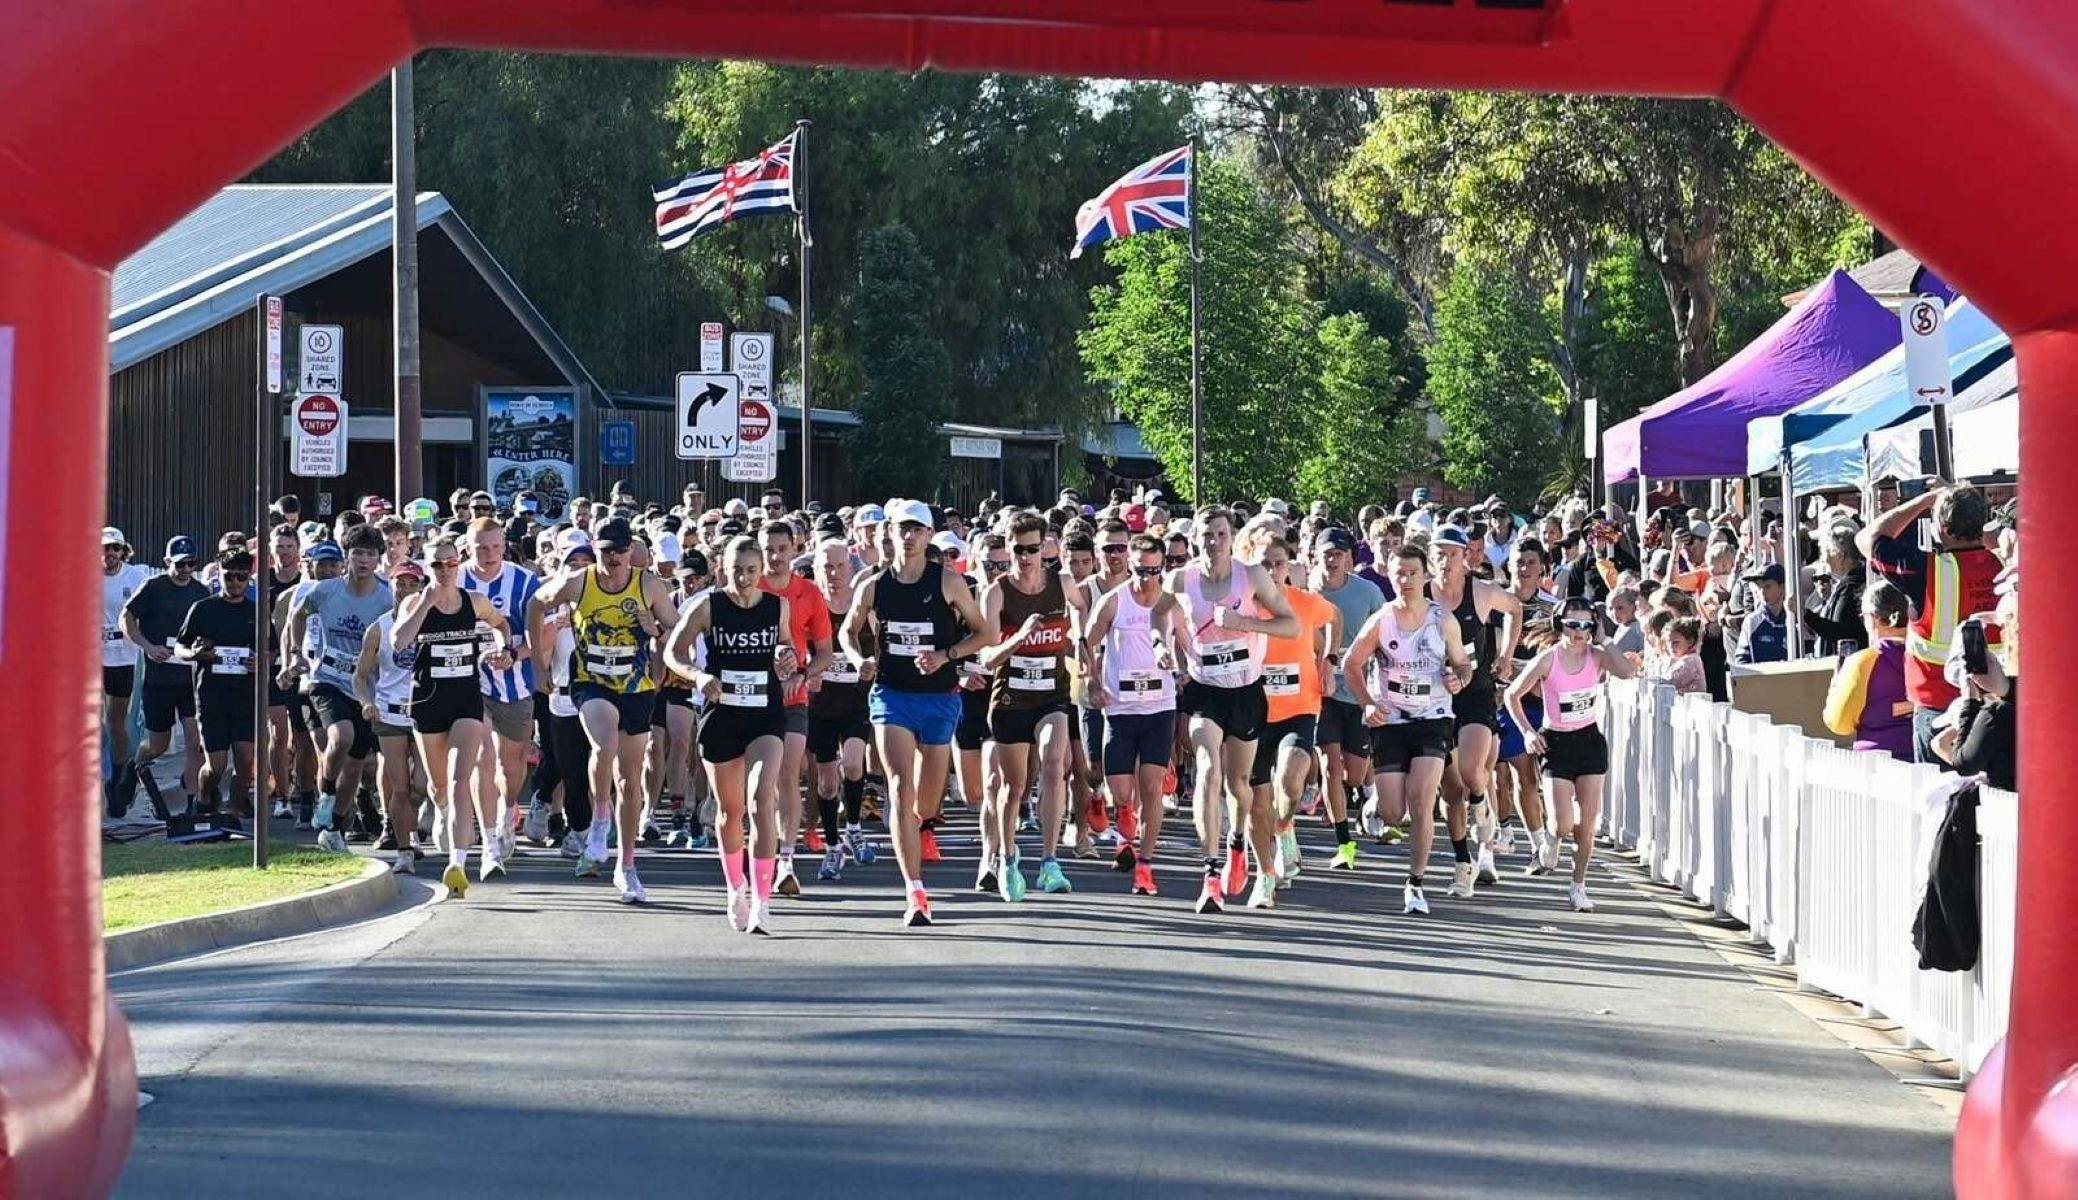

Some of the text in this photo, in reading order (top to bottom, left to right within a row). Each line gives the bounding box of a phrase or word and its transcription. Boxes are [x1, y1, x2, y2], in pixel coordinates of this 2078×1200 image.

[314, 335, 326, 348] 10
[747, 343, 758, 355] 10
[738, 363, 766, 371] SHARED
[312, 402, 326, 411] NO
[744, 407, 758, 415] NO
[304, 420, 333, 431] ENTRY
[740, 427, 764, 436] NTRY
[682, 434, 733, 449] ONLY
[505, 449, 570, 461] ENTER HERE
[712, 625, 778, 647] livsstil
[900, 634, 920, 645] 139
[1216, 651, 1235, 664] 171
[735, 683, 755, 694] 591
